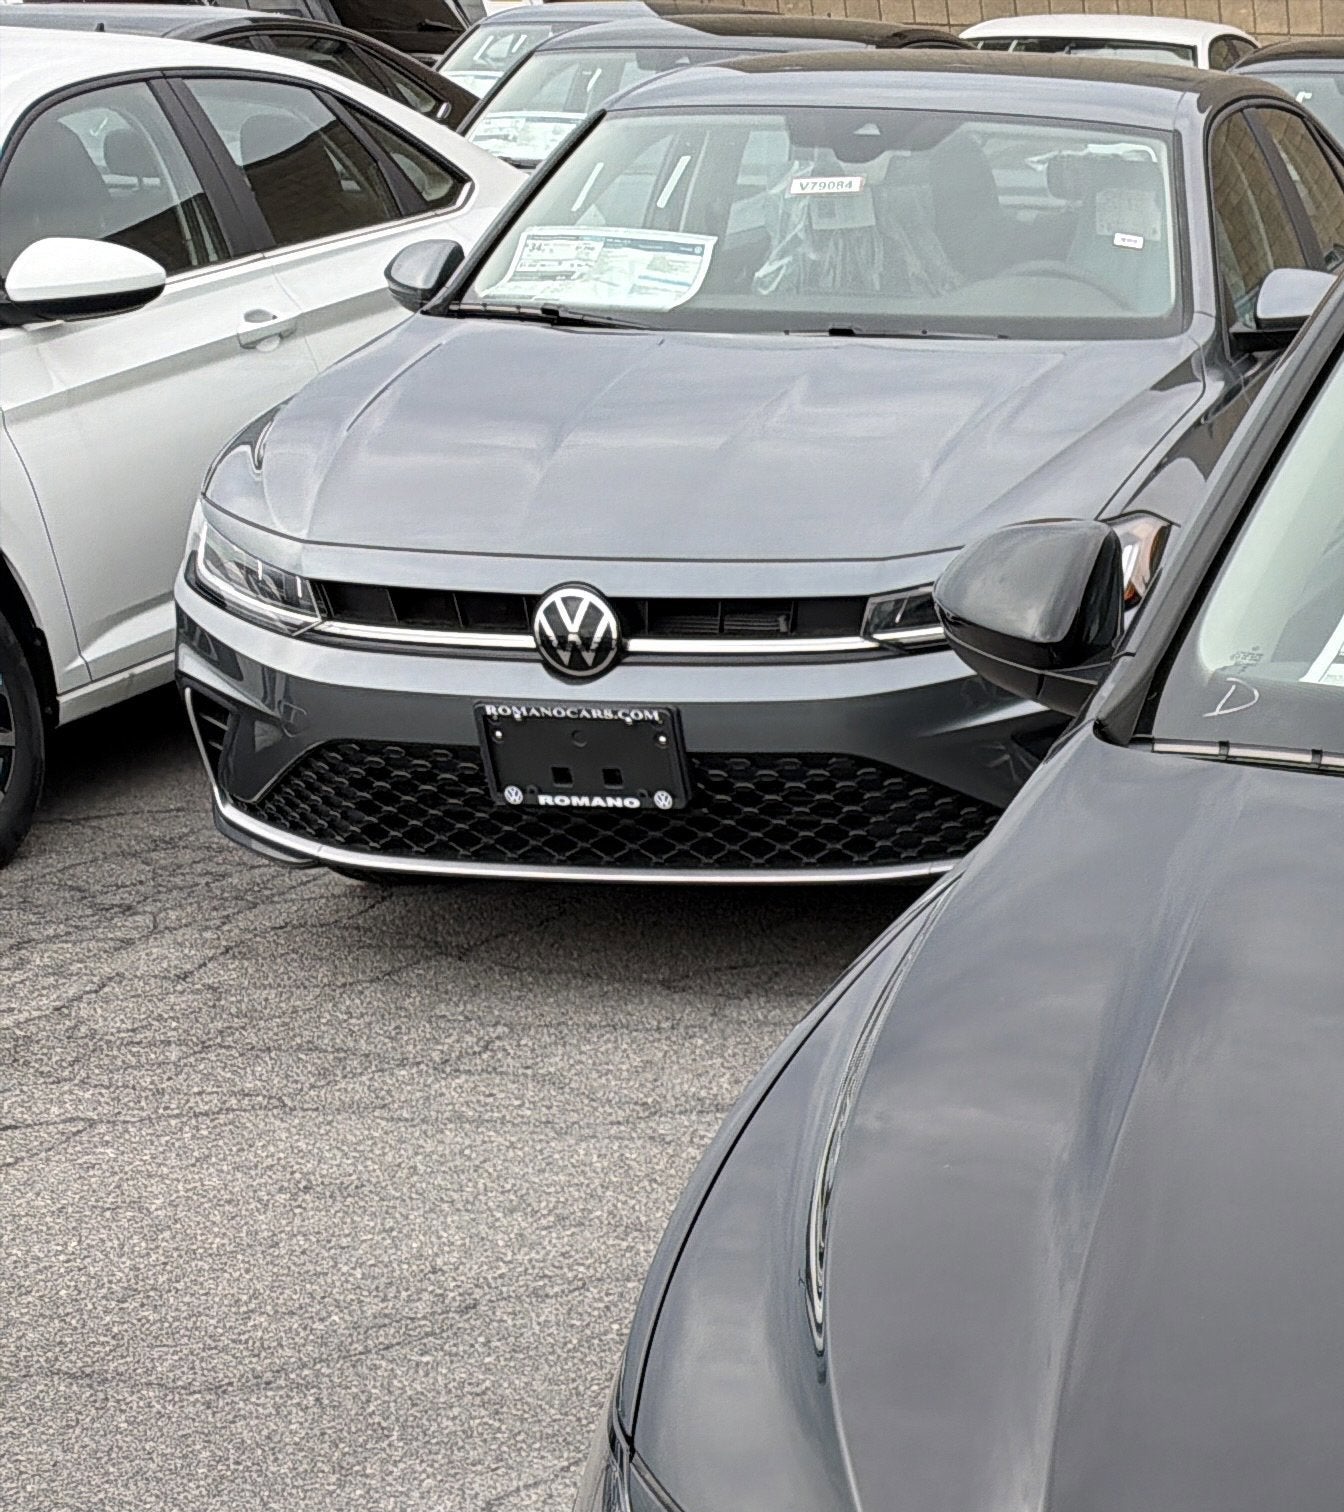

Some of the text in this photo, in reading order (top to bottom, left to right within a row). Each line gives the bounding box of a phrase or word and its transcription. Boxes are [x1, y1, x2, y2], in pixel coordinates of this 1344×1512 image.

[799, 180, 853, 191] V79084
[485, 704, 660, 721] ROMANOCARS.COM
[537, 794, 641, 809] ROMANO
